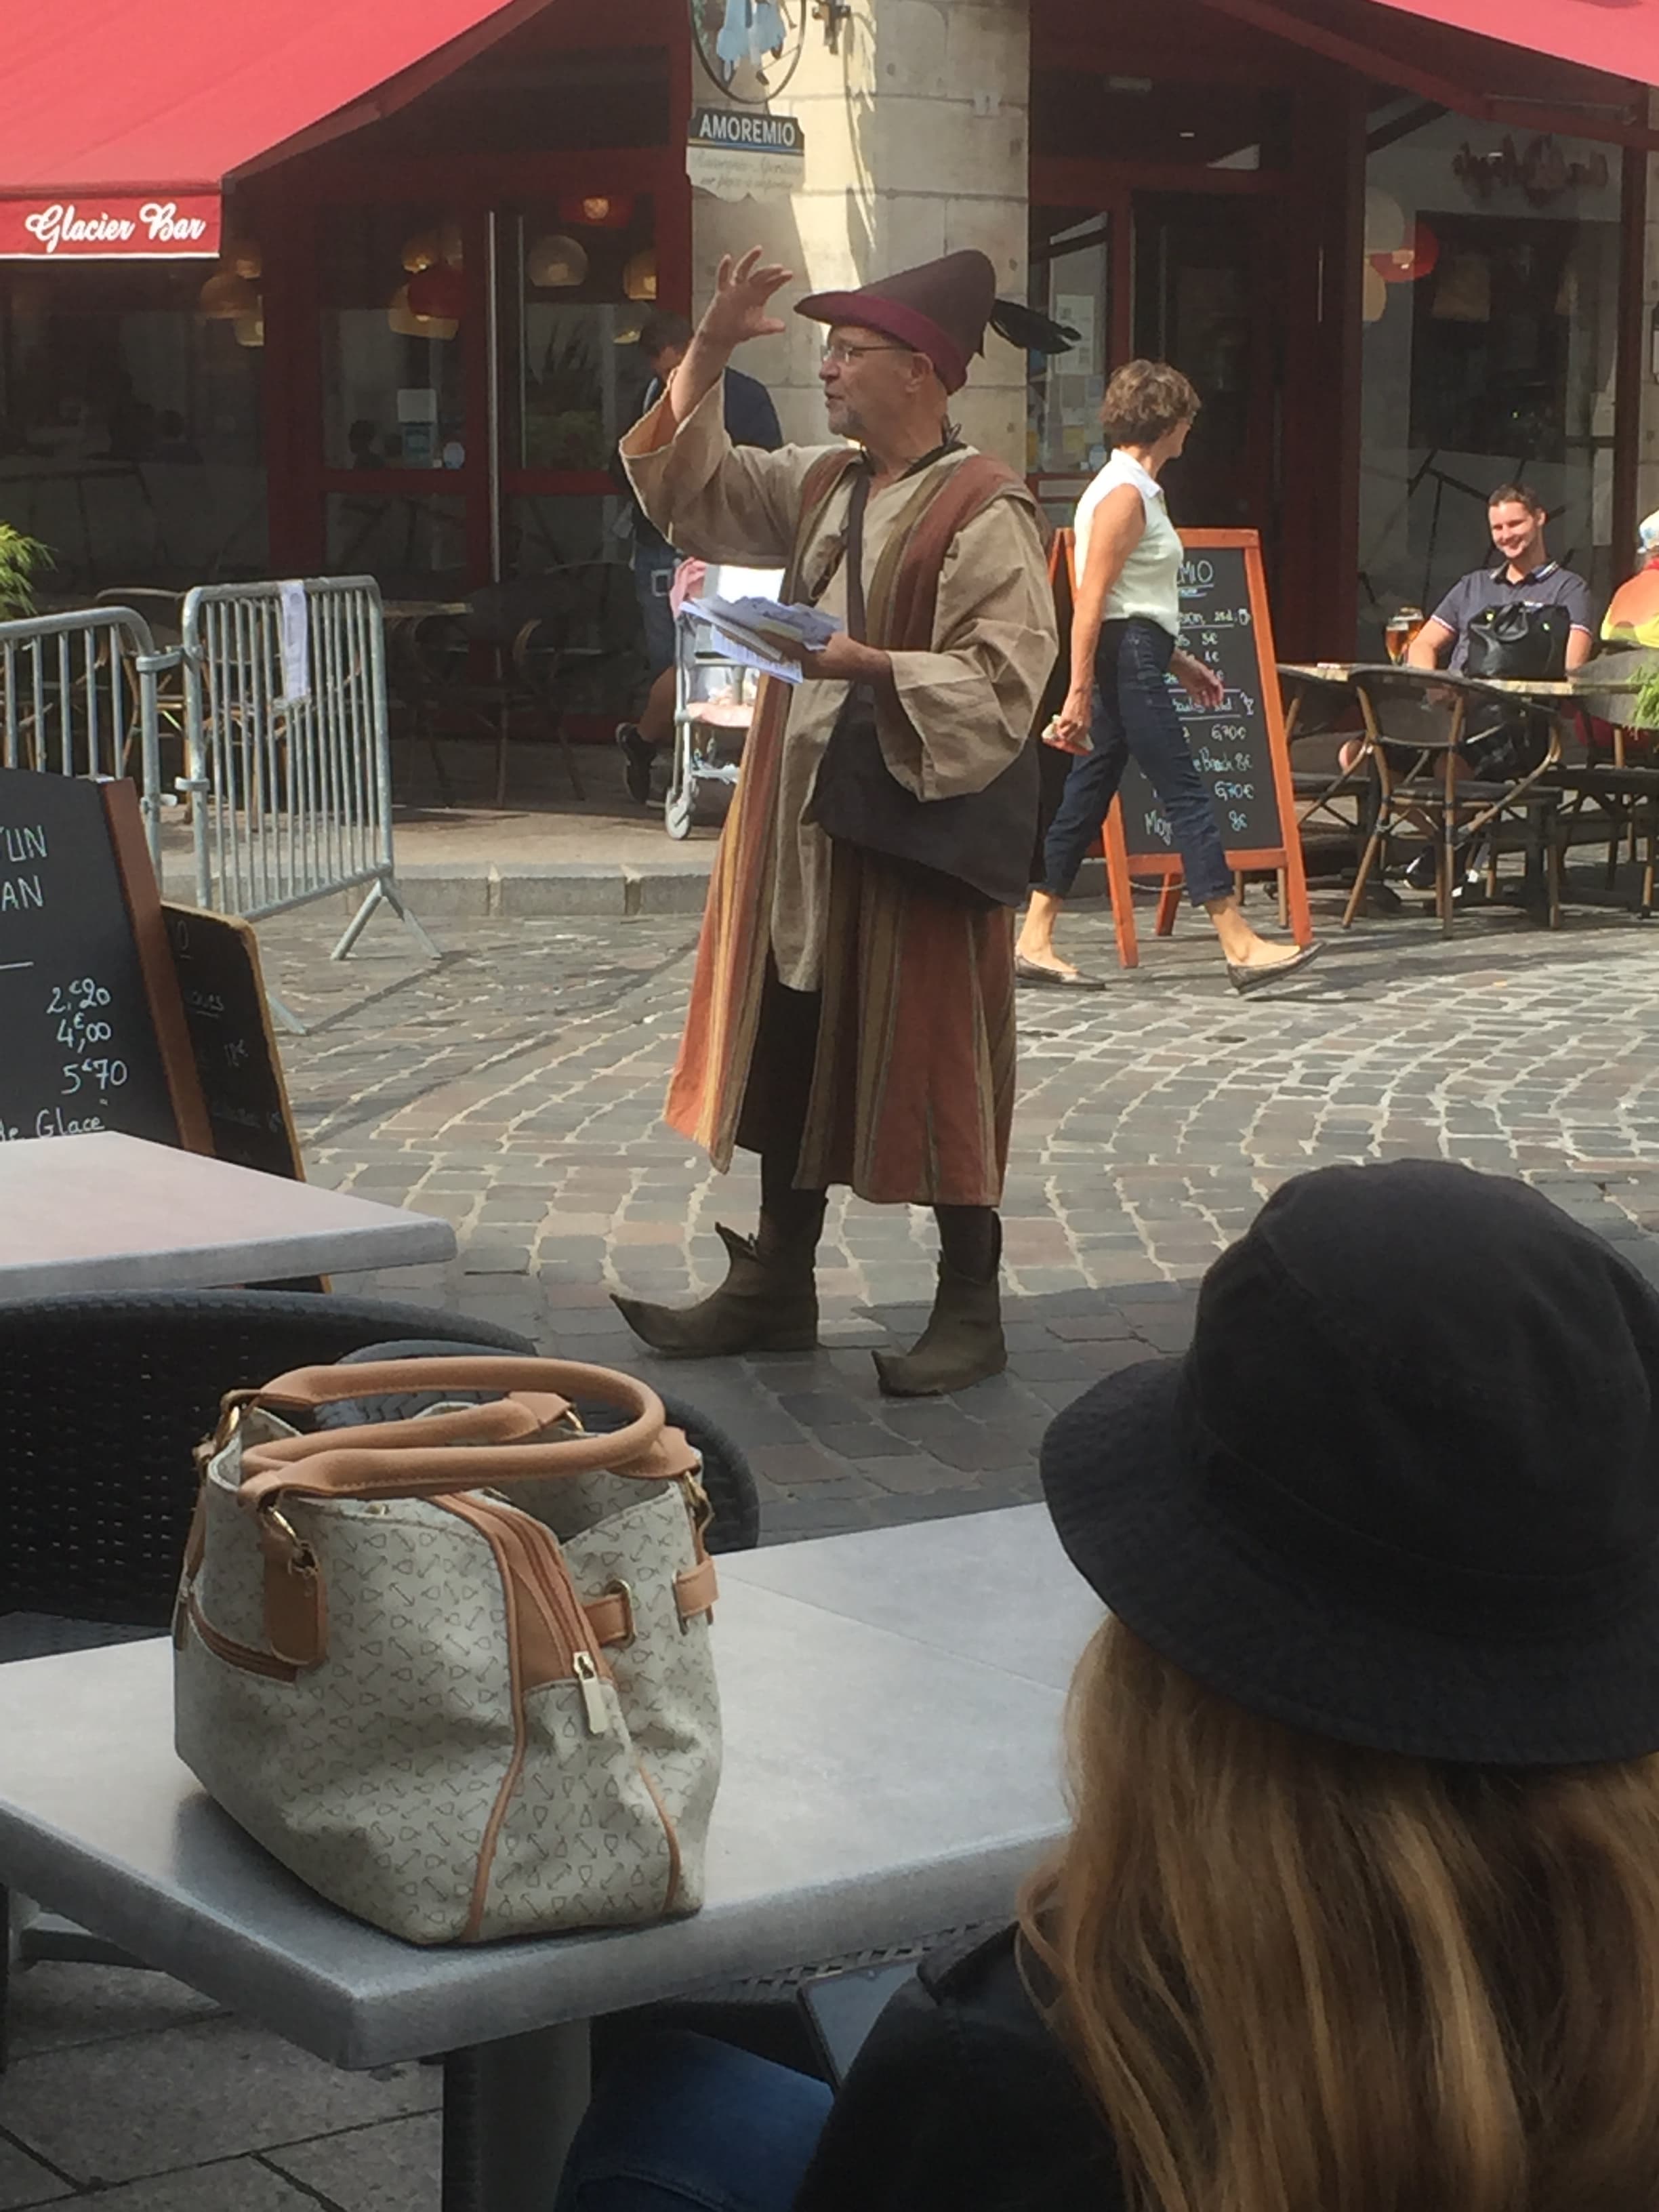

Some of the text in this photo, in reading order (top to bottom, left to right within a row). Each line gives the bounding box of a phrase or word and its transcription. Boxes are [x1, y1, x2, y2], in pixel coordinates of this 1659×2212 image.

[699, 114, 796, 146] AMOREMIO
[25, 203, 206, 253] Glacier Bar
[0, 825, 47, 862] UN
[36, 1107, 105, 1139] Glace
